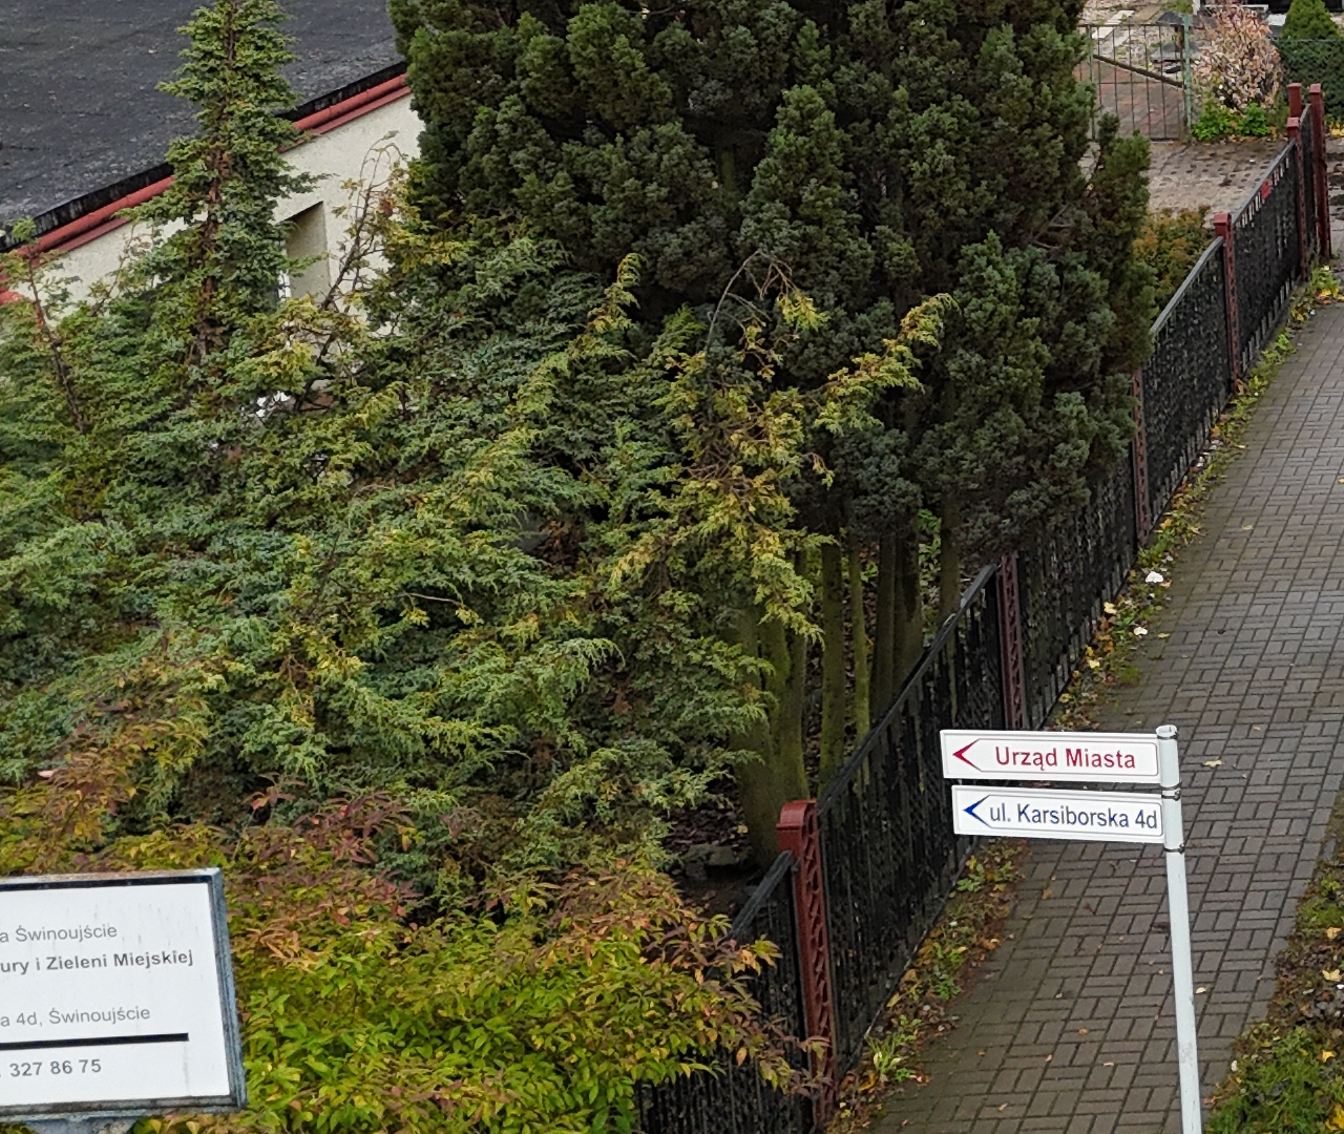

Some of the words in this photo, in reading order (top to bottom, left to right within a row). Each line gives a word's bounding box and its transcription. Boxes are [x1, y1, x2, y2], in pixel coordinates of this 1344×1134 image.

[995, 746, 1058, 771] Urząd
[1065, 748, 1136, 769] Miasta
[989, 802, 1011, 823] ul.
[1017, 803, 1130, 828] Karsiborska
[1135, 809, 1158, 829] 4d
[15, 924, 118, 943] Świnoujście
[35, 957, 41, 971] i
[46, 954, 108, 971] Zieleni
[113, 949, 194, 969] Miejskiej
[16, 1011, 43, 1027] 4d,
[48, 1006, 151, 1025] Świnoujście
[9, 1061, 43, 1078] 327
[49, 1059, 73, 1075] 86
[78, 1058, 102, 1074] 75
